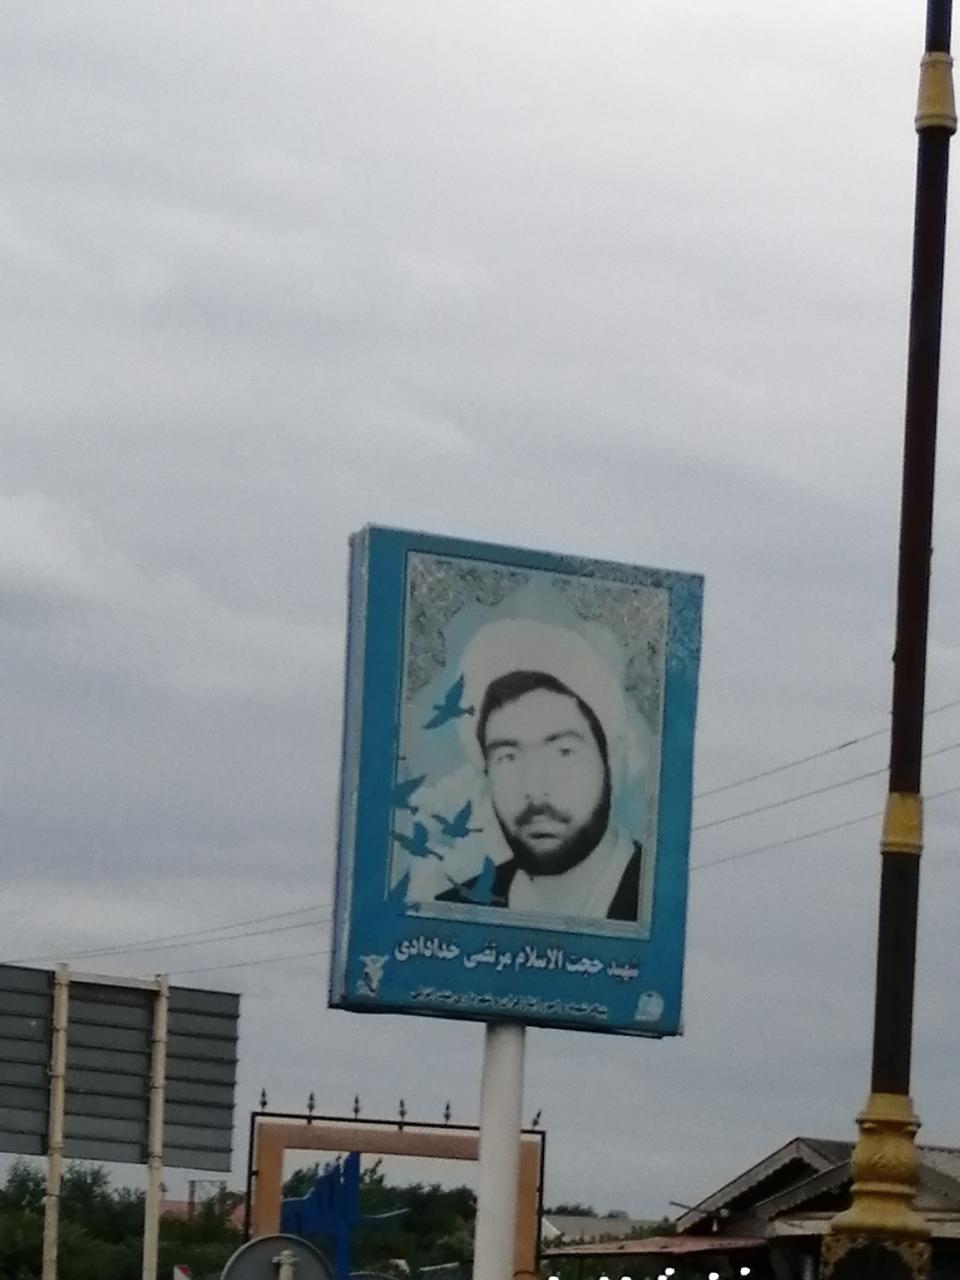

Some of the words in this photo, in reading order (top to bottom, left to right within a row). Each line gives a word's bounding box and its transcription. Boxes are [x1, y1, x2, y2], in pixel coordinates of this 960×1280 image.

[394, 936, 461, 961] خدادادی
[463, 943, 512, 971] مرتضی
[565, 955, 604, 979] حجت
